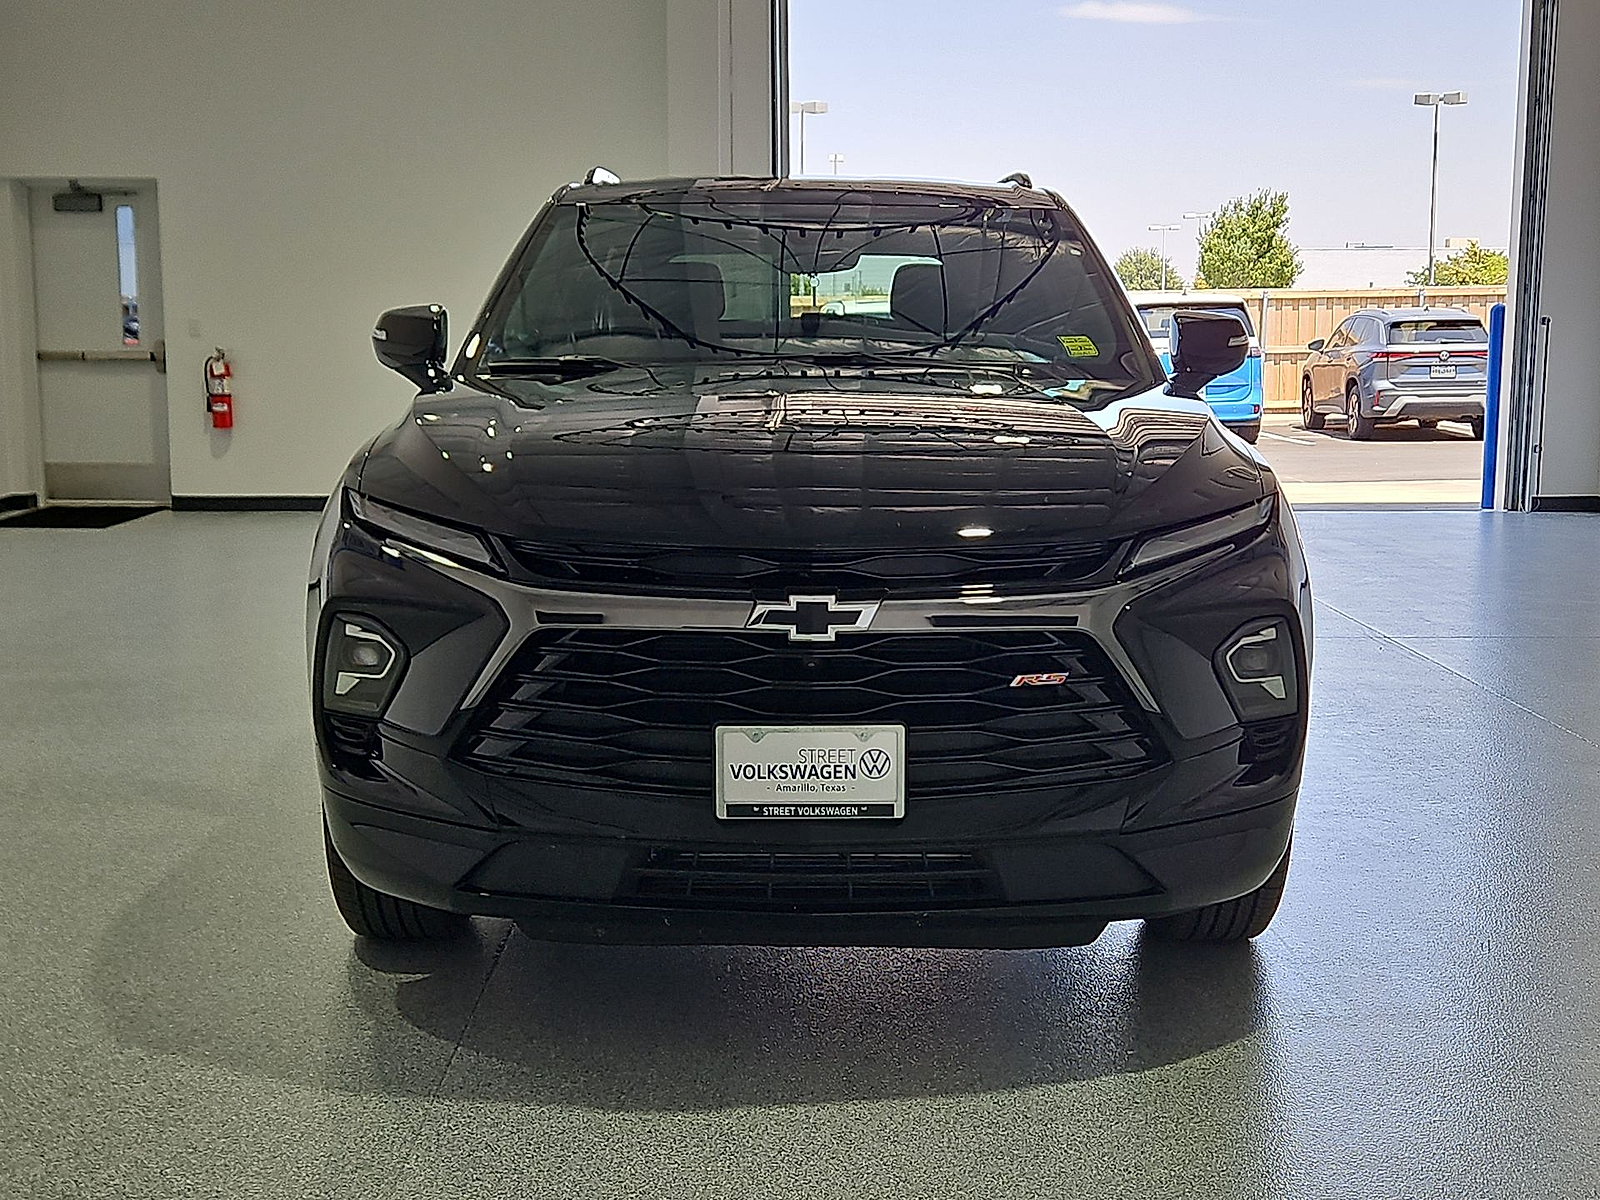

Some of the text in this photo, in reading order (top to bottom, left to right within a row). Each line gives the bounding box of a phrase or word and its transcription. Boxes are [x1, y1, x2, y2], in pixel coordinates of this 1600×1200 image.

[1010, 672, 1069, 687] RS
[798, 749, 856, 764] STREET
[729, 764, 857, 780] VOLKSWAGEN
[775, 783, 846, 793] Amarillo, Texas
[763, 807, 858, 816] STREET VOLKSWAGEN
